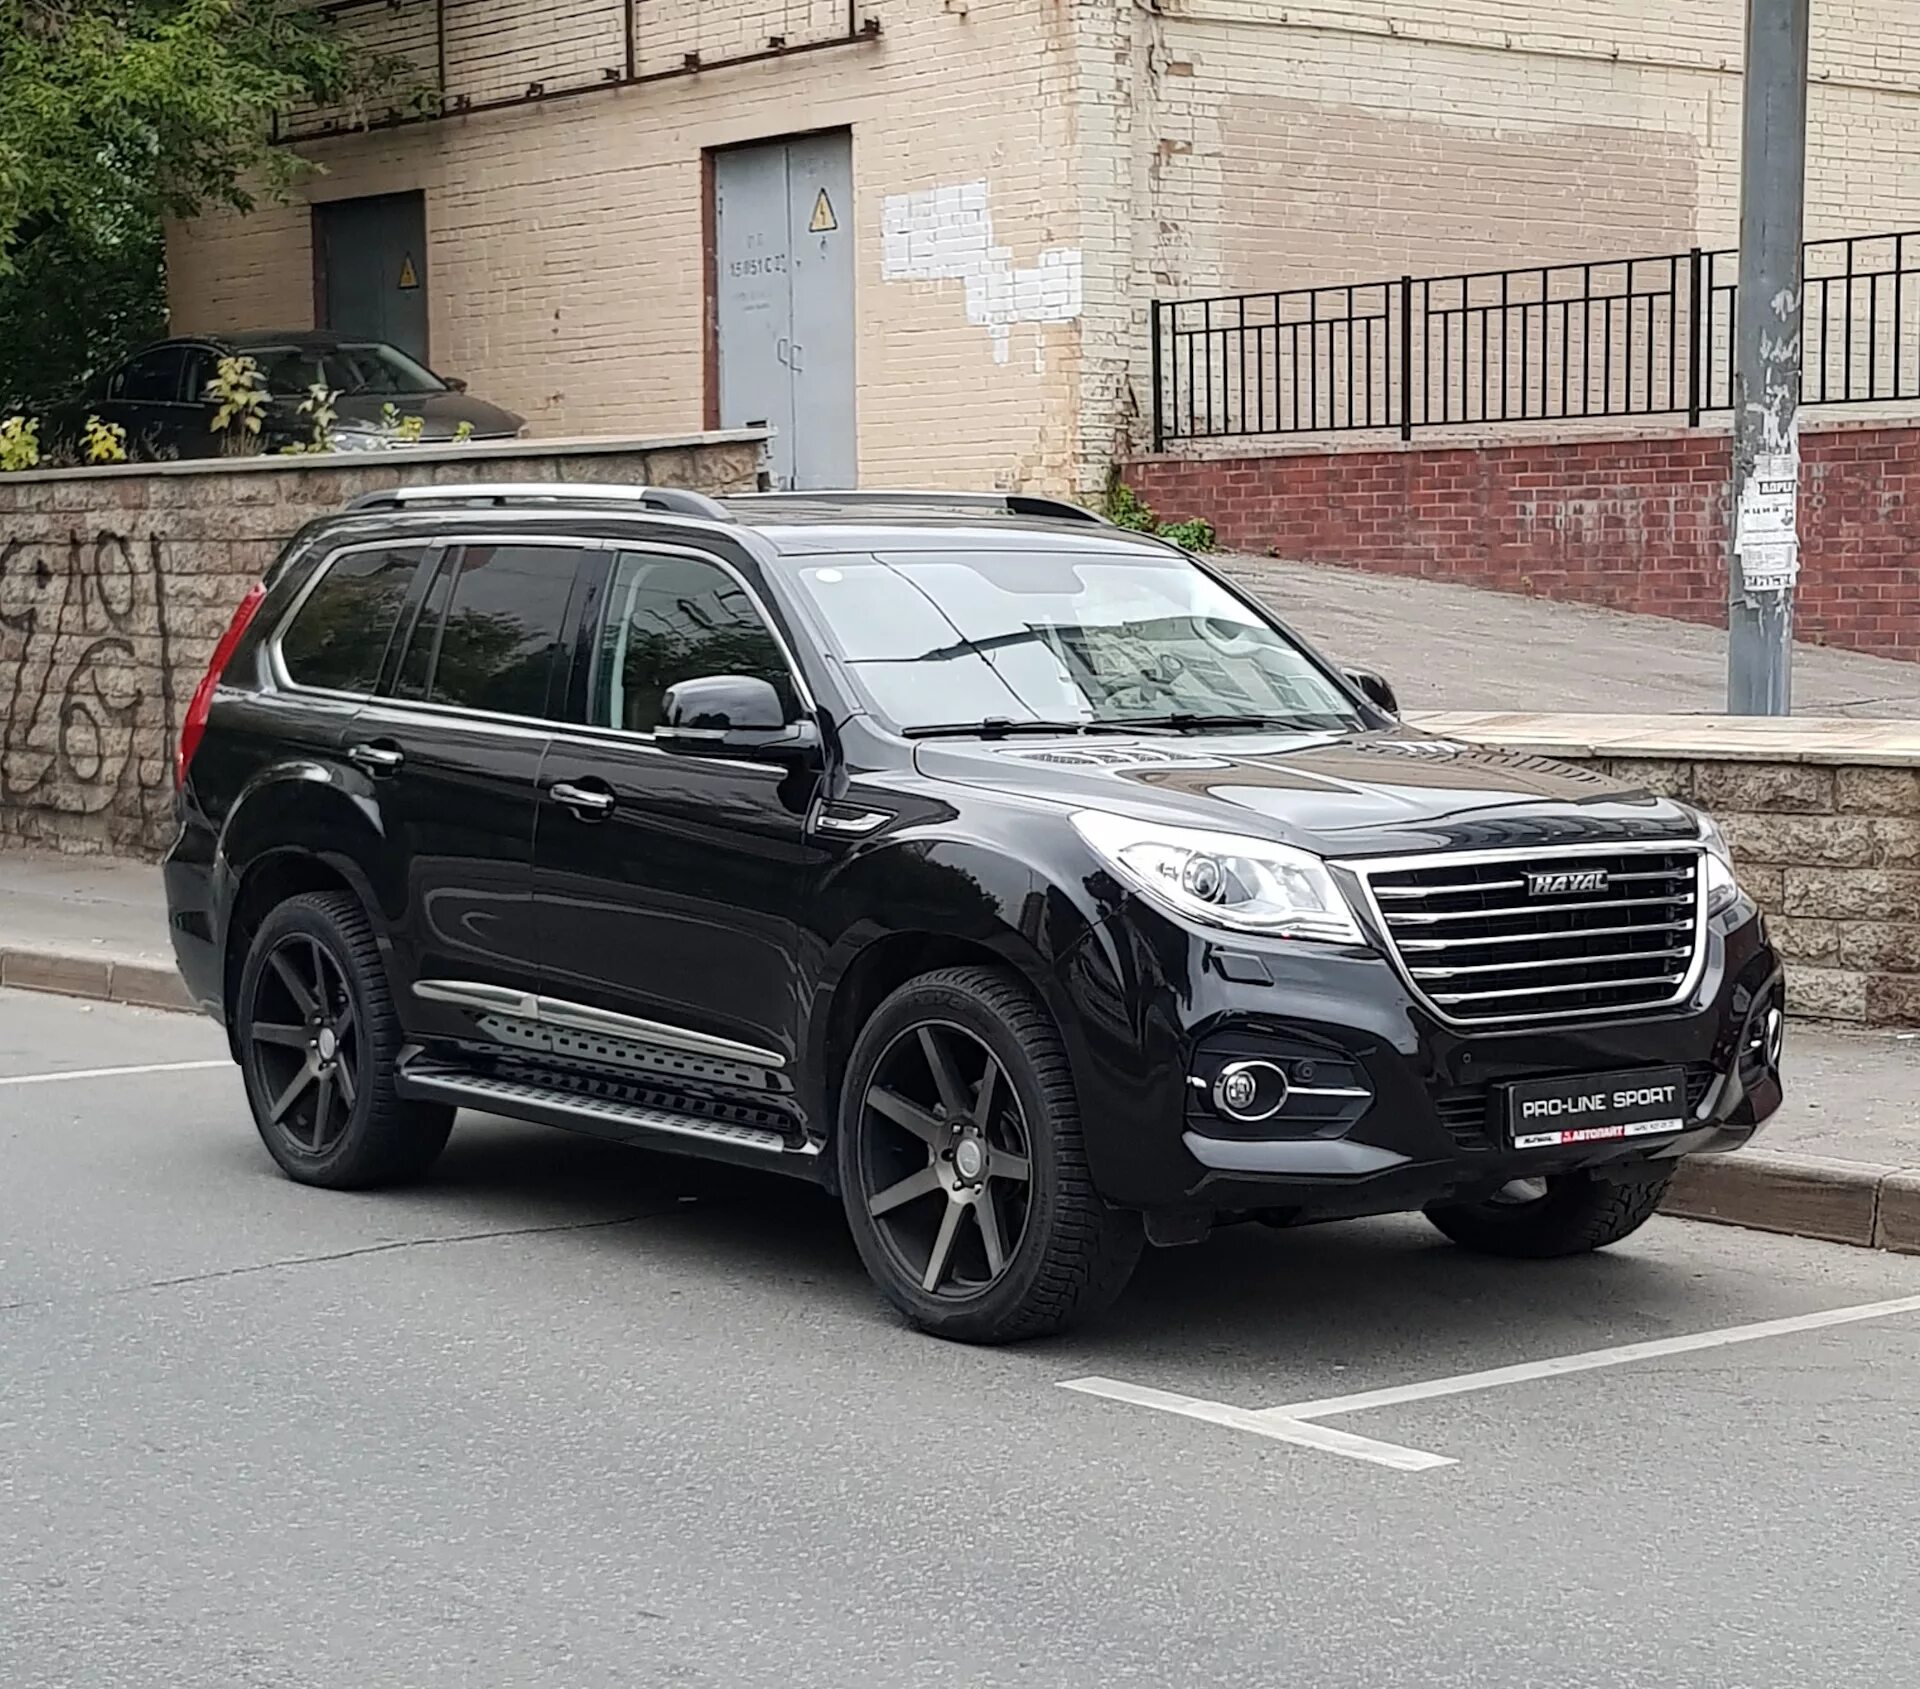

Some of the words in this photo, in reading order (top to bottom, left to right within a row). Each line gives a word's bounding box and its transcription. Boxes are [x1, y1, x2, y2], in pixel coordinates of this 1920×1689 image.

[1533, 874, 1607, 893] HAVAL
[1522, 1094, 1606, 1118] PRO-LINE
[1613, 1086, 1675, 1108] SPORT
